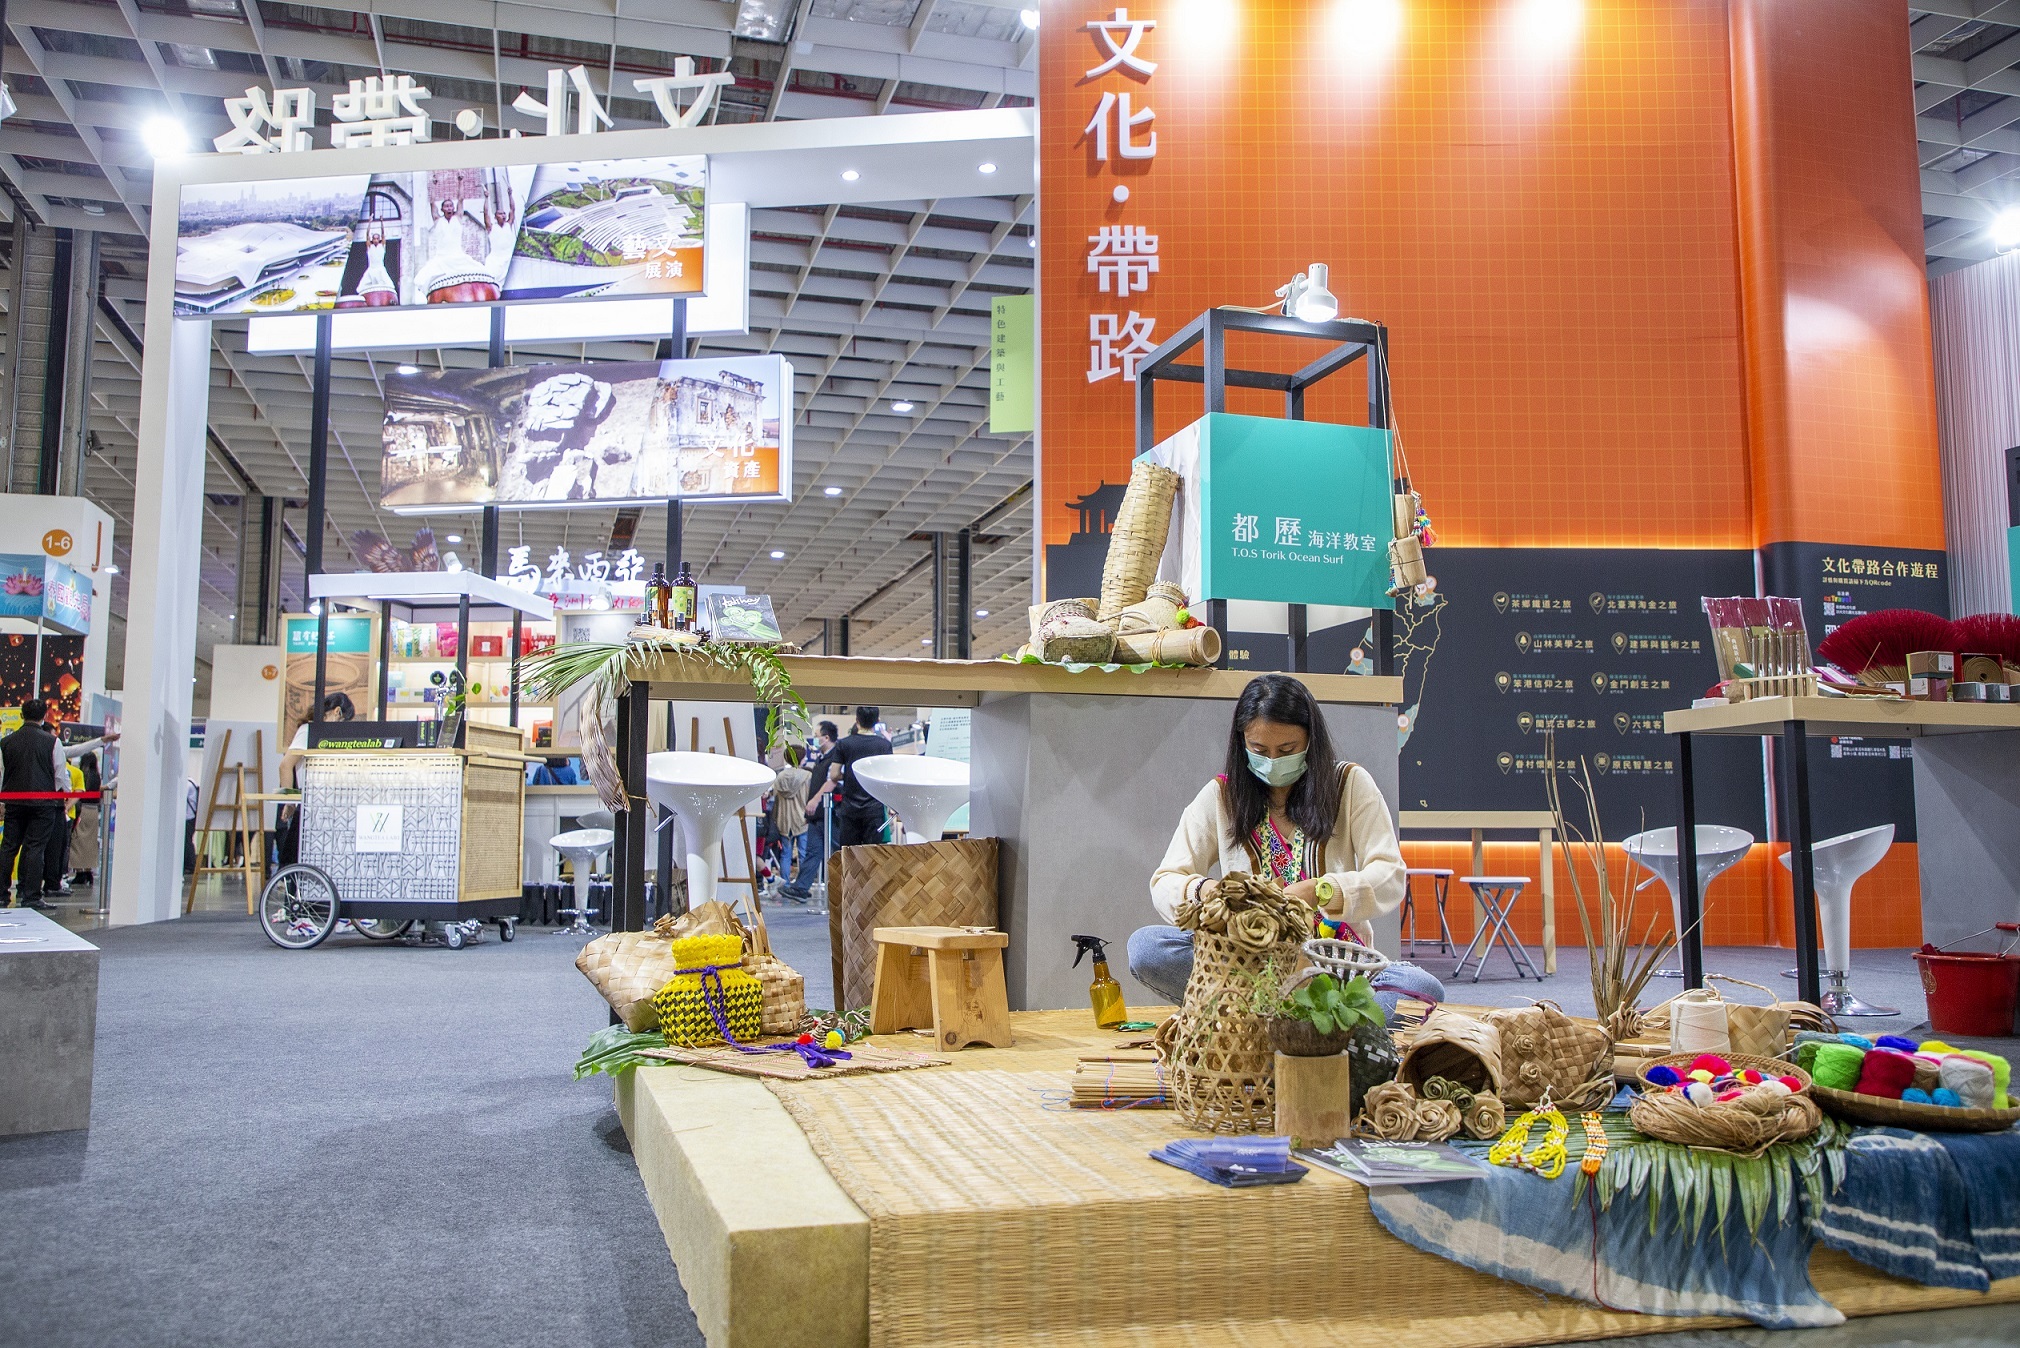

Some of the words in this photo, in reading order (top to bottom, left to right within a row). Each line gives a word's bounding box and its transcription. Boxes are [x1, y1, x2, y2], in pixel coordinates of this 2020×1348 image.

[623, 233, 677, 260] 藝文
[645, 260, 683, 279] 展演
[701, 432, 756, 458] 文化
[724, 460, 761, 479] 資產
[45, 535, 71, 550] 1-6
[1307, 530, 1377, 552] 海洋教室
[1231, 547, 1258, 559] T.O.S
[1261, 549, 1287, 561] Torik
[1288, 551, 1321, 564] Ocean
[1323, 554, 1344, 565] Surf
[1822, 556, 1939, 579] 文化帶路合作遊程
[1533, 639, 1594, 649] 山林美學之旅
[318, 739, 382, 750] @wangtealab
